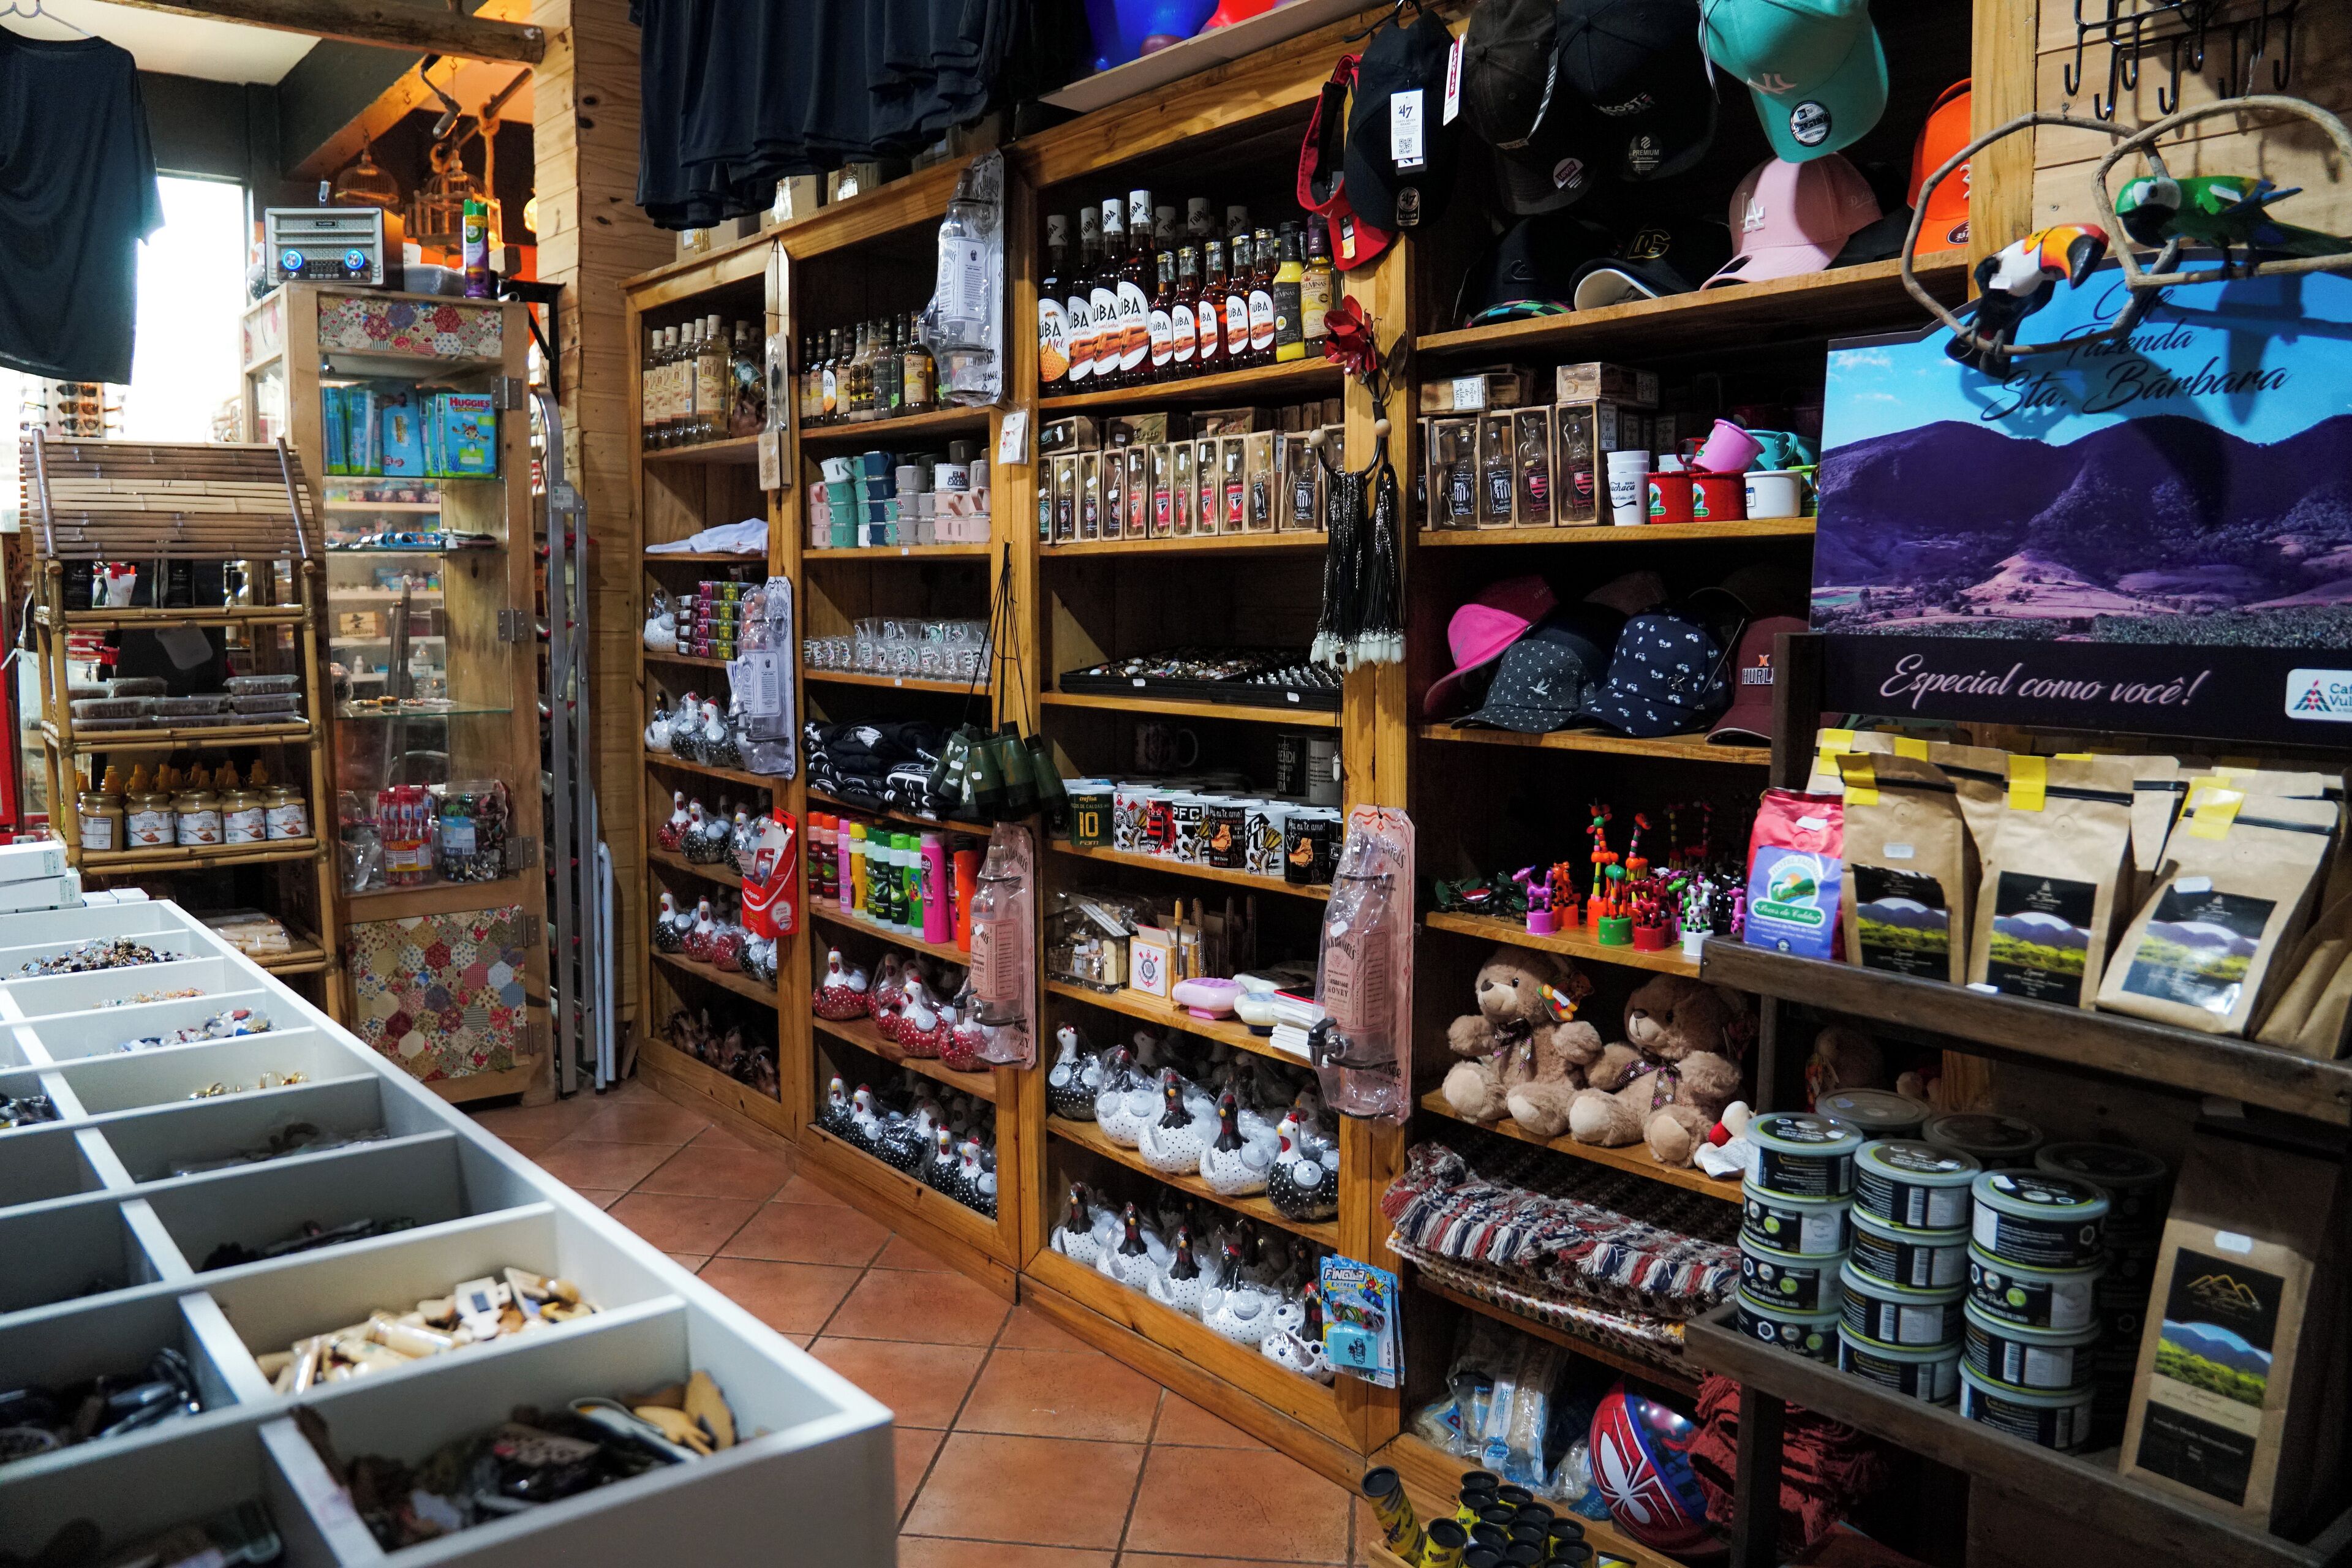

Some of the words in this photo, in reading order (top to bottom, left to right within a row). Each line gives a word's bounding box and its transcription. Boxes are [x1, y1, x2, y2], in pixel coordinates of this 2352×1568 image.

[1740, 192, 1765, 233] LA
[1042, 337, 1066, 355] Mel
[2060, 317, 2199, 367] Fazenda
[2082, 356, 2293, 414] Bárbara
[449, 396, 491, 408] HUGGIES
[1981, 369, 2067, 421] Sta.
[1742, 668, 1774, 685] HURL
[1880, 654, 2023, 709] Especial
[2018, 677, 2109, 700] como
[2109, 670, 2211, 706] você!
[1221, 809, 1227, 818] te
[1229, 809, 1242, 818] amo!
[1079, 812, 1099, 838] 10
[1305, 821, 1311, 830] te
[1311, 821, 1325, 831] amo!
[744, 887, 760, 901] Colgate
[1779, 908, 1790, 916] de
[1328, 986, 1348, 997] HONEY
